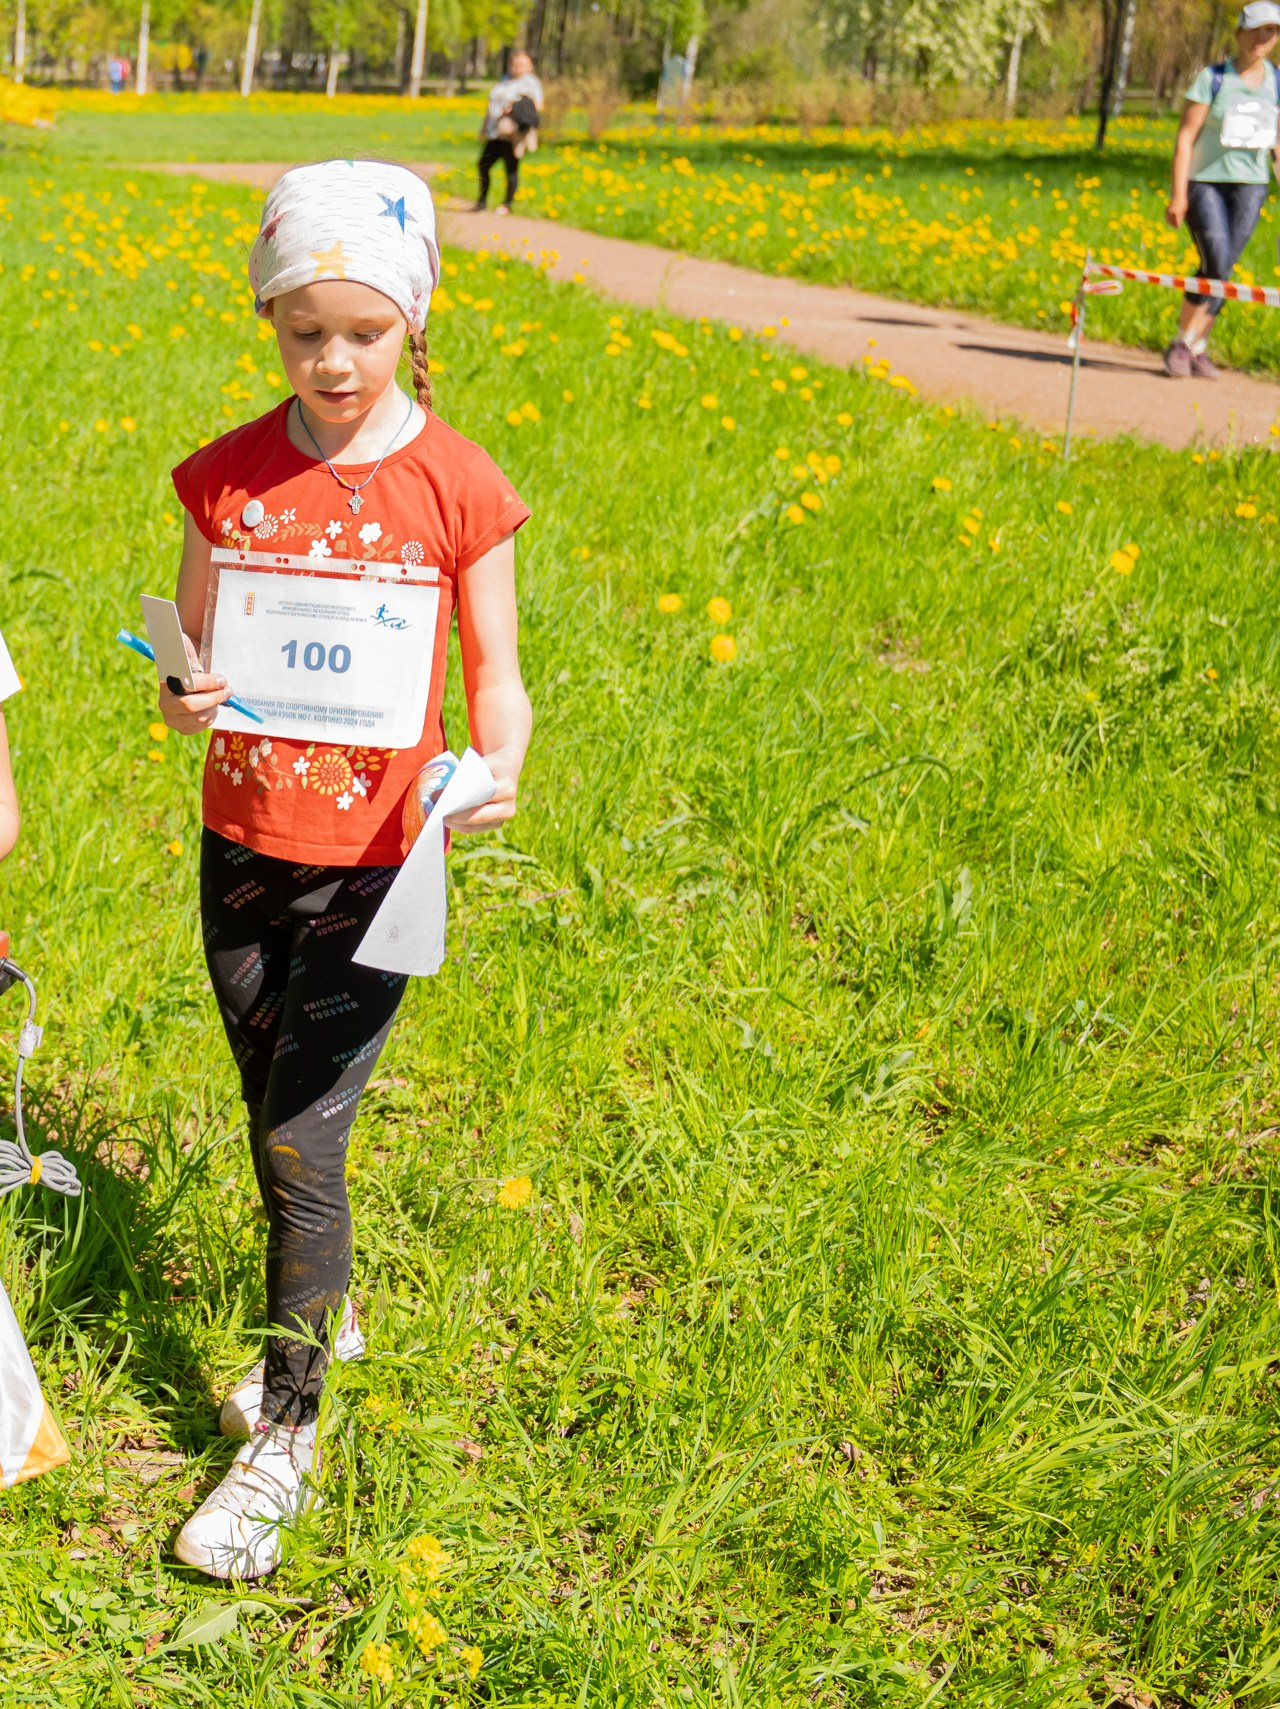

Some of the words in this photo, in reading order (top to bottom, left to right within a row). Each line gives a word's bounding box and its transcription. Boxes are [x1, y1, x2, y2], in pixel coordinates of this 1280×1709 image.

[281, 640, 351, 673] 100
[276, 701, 285, 709] ПО
[286, 703, 328, 714] СПОРТИВНОМУ
[329, 707, 385, 719] ОРИЕНТИРОВАНИЮ
[278, 711, 297, 719] КУБОК
[314, 715, 342, 724] КОЛПИНО
[344, 718, 358, 726] 2024
[232, 850, 258, 866] FORE
[230, 951, 259, 985] UNICORN
[302, 991, 350, 1013] UNICORN
[309, 1001, 359, 1022] FOREVER
